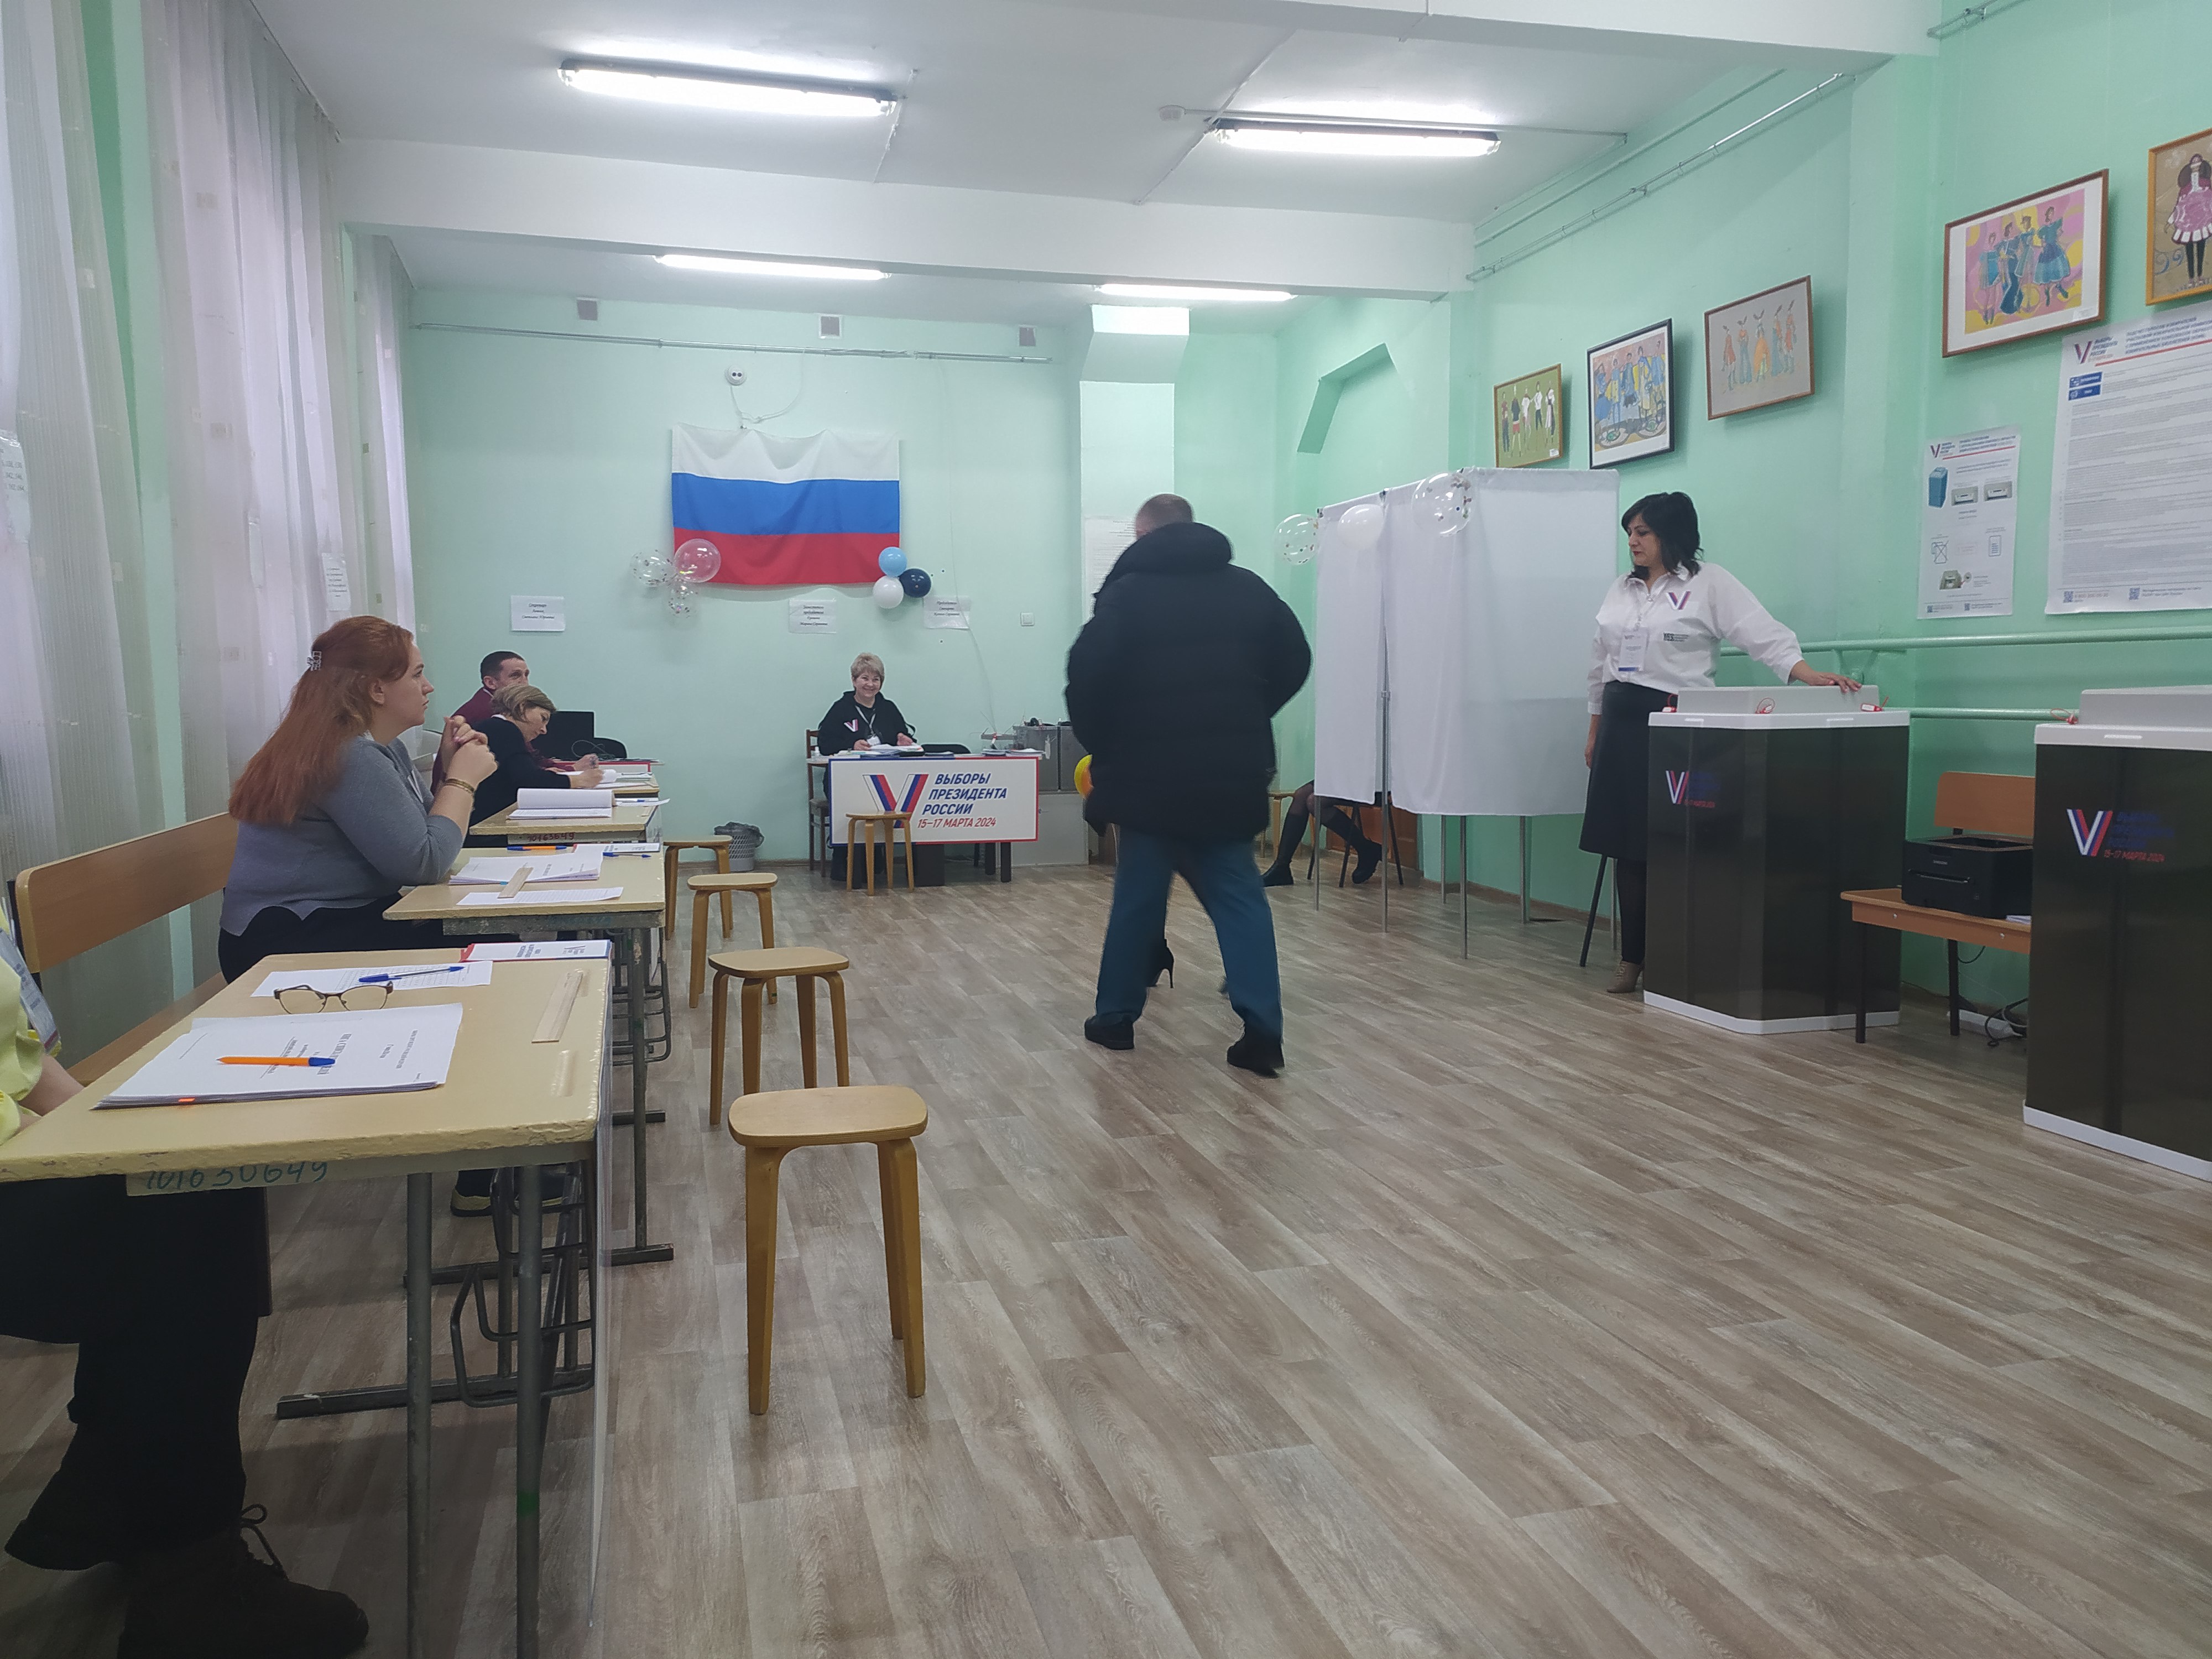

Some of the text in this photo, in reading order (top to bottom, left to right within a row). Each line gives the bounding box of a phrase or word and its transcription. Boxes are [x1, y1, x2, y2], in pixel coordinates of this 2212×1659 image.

[935, 773, 991, 785] ВЫБОРЫ
[928, 788, 1008, 801] ПРЕЗИДЕНТА
[922, 804, 973, 815] РОССИИ
[944, 818, 973, 828] МАРТА
[974, 817, 997, 827] 2024
